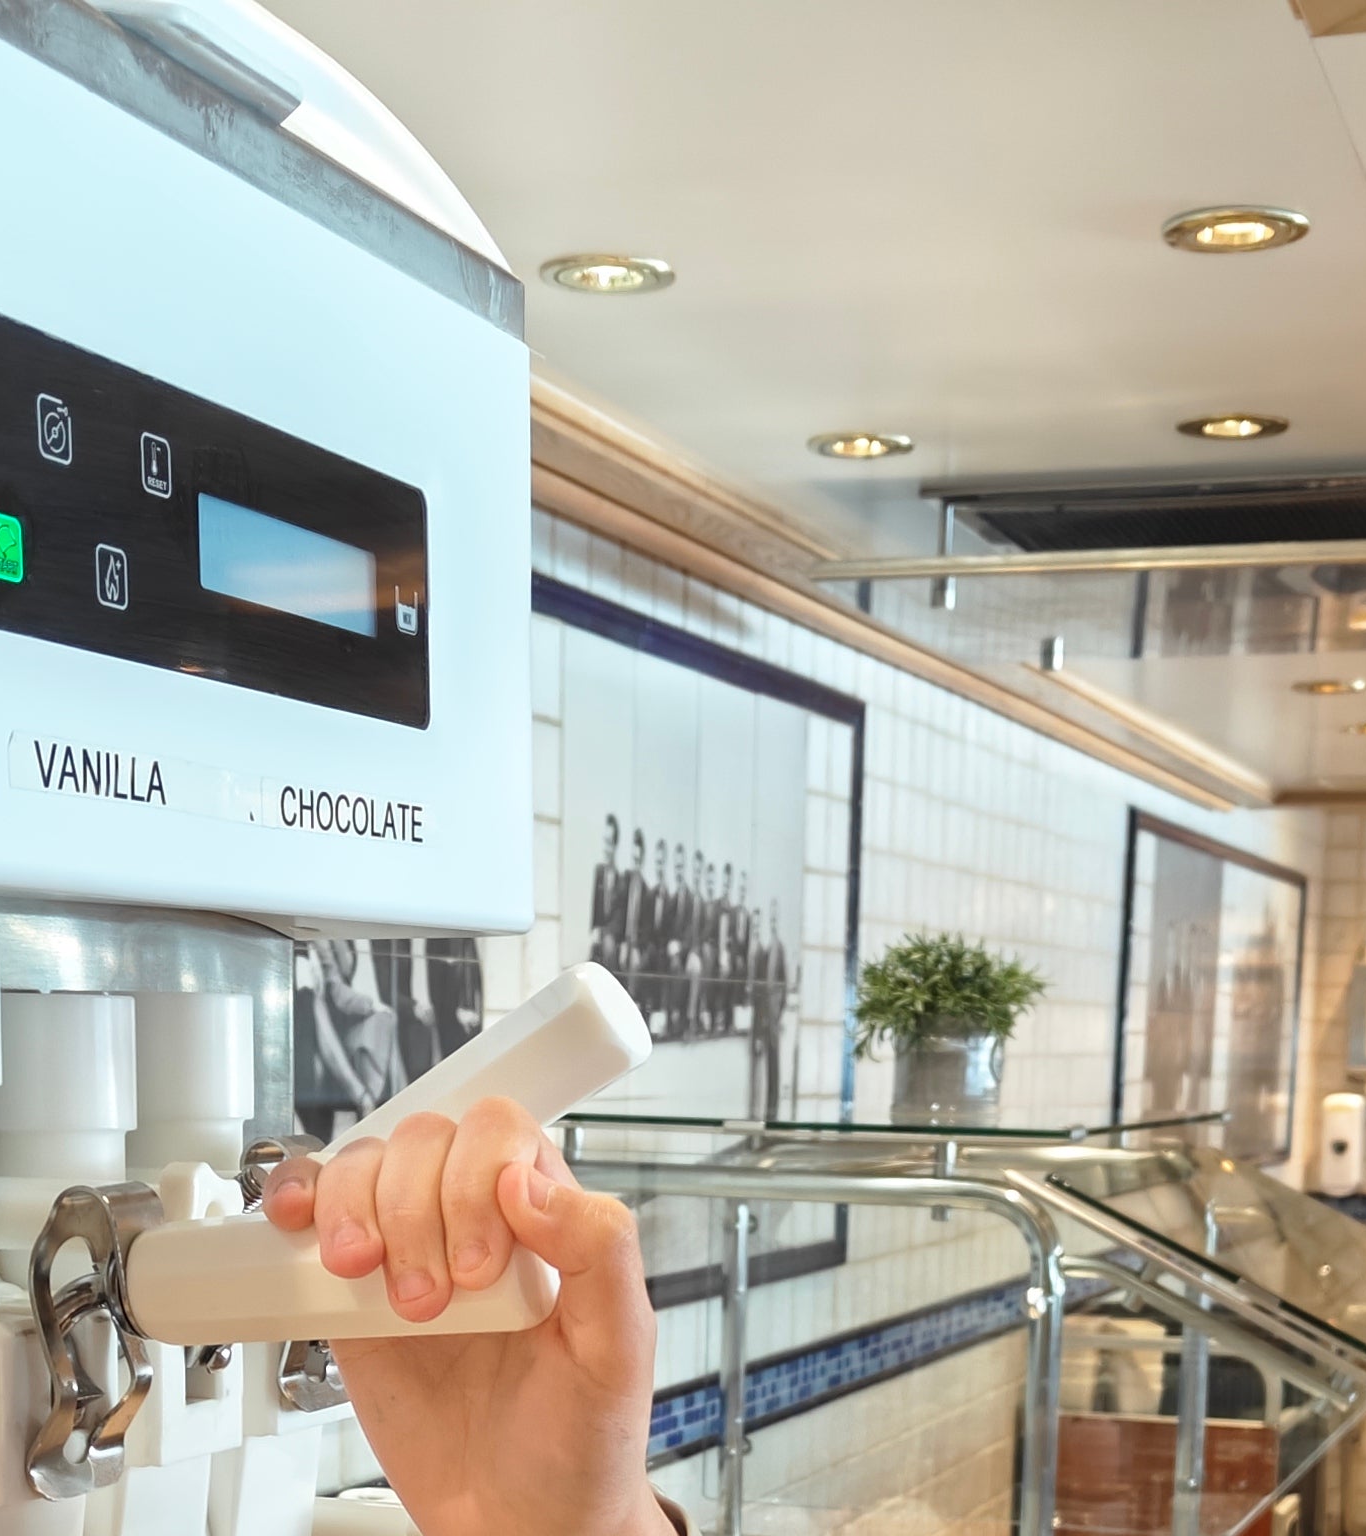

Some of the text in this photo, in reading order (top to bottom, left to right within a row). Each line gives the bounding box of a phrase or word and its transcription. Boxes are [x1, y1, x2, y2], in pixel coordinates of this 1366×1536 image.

[147, 476, 167, 491] RESET
[33, 739, 166, 805] VANILLA
[280, 785, 423, 843] CHOCOLATE
